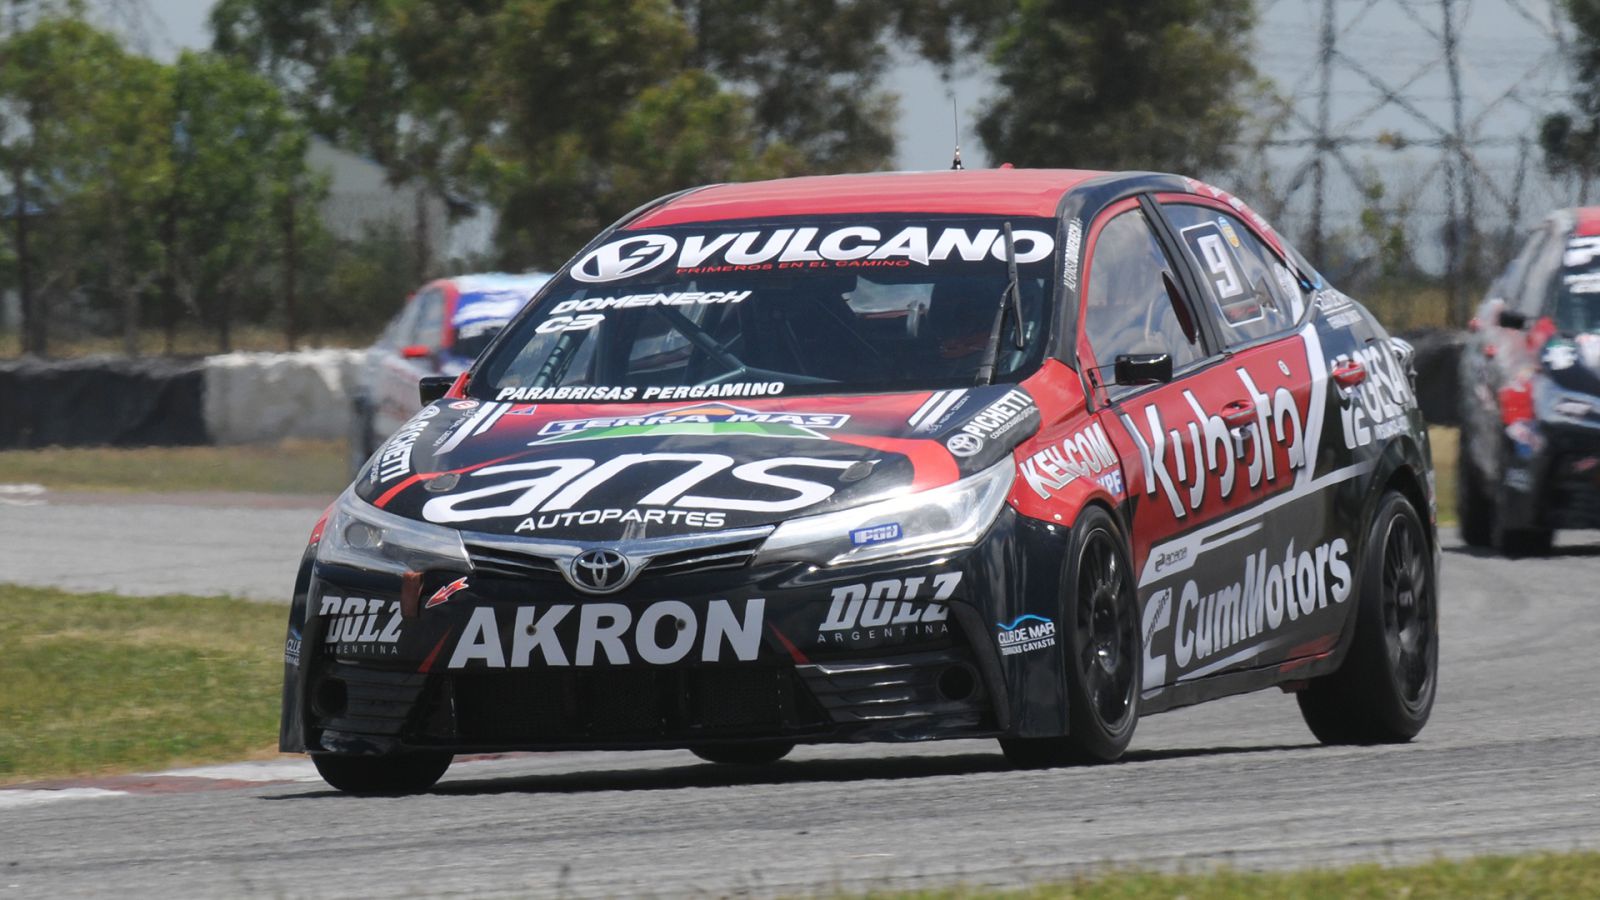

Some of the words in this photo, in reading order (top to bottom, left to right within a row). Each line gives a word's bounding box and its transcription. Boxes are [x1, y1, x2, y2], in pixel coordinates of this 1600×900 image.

[677, 226, 1055, 270] VULCANO
[676, 264, 773, 275] PRIMEROS
[778, 262, 804, 270] EN
[810, 260, 829, 268] EL
[835, 259, 911, 268] CAMINO
[1197, 234, 1244, 299] 9
[549, 290, 752, 315] DOMENECH
[534, 313, 606, 334] C3
[496, 386, 637, 401] PARABRISAS
[642, 382, 785, 400] PERGAMINO
[557, 414, 709, 431] TERRA
[726, 413, 834, 426] MAS
[962, 389, 1034, 438] PICHETTI
[514, 509, 726, 533] AUTOPARTES
[818, 571, 963, 631] DOLZ
[1174, 537, 1352, 668] CumMotors
[319, 595, 403, 643] DOLZ
[447, 598, 766, 669] AKRON
[817, 623, 949, 644] ARGENTINA
[1014, 628, 1028, 642] DE
[1028, 622, 1056, 637] MAR
[1022, 638, 1056, 653] CAYASTA
